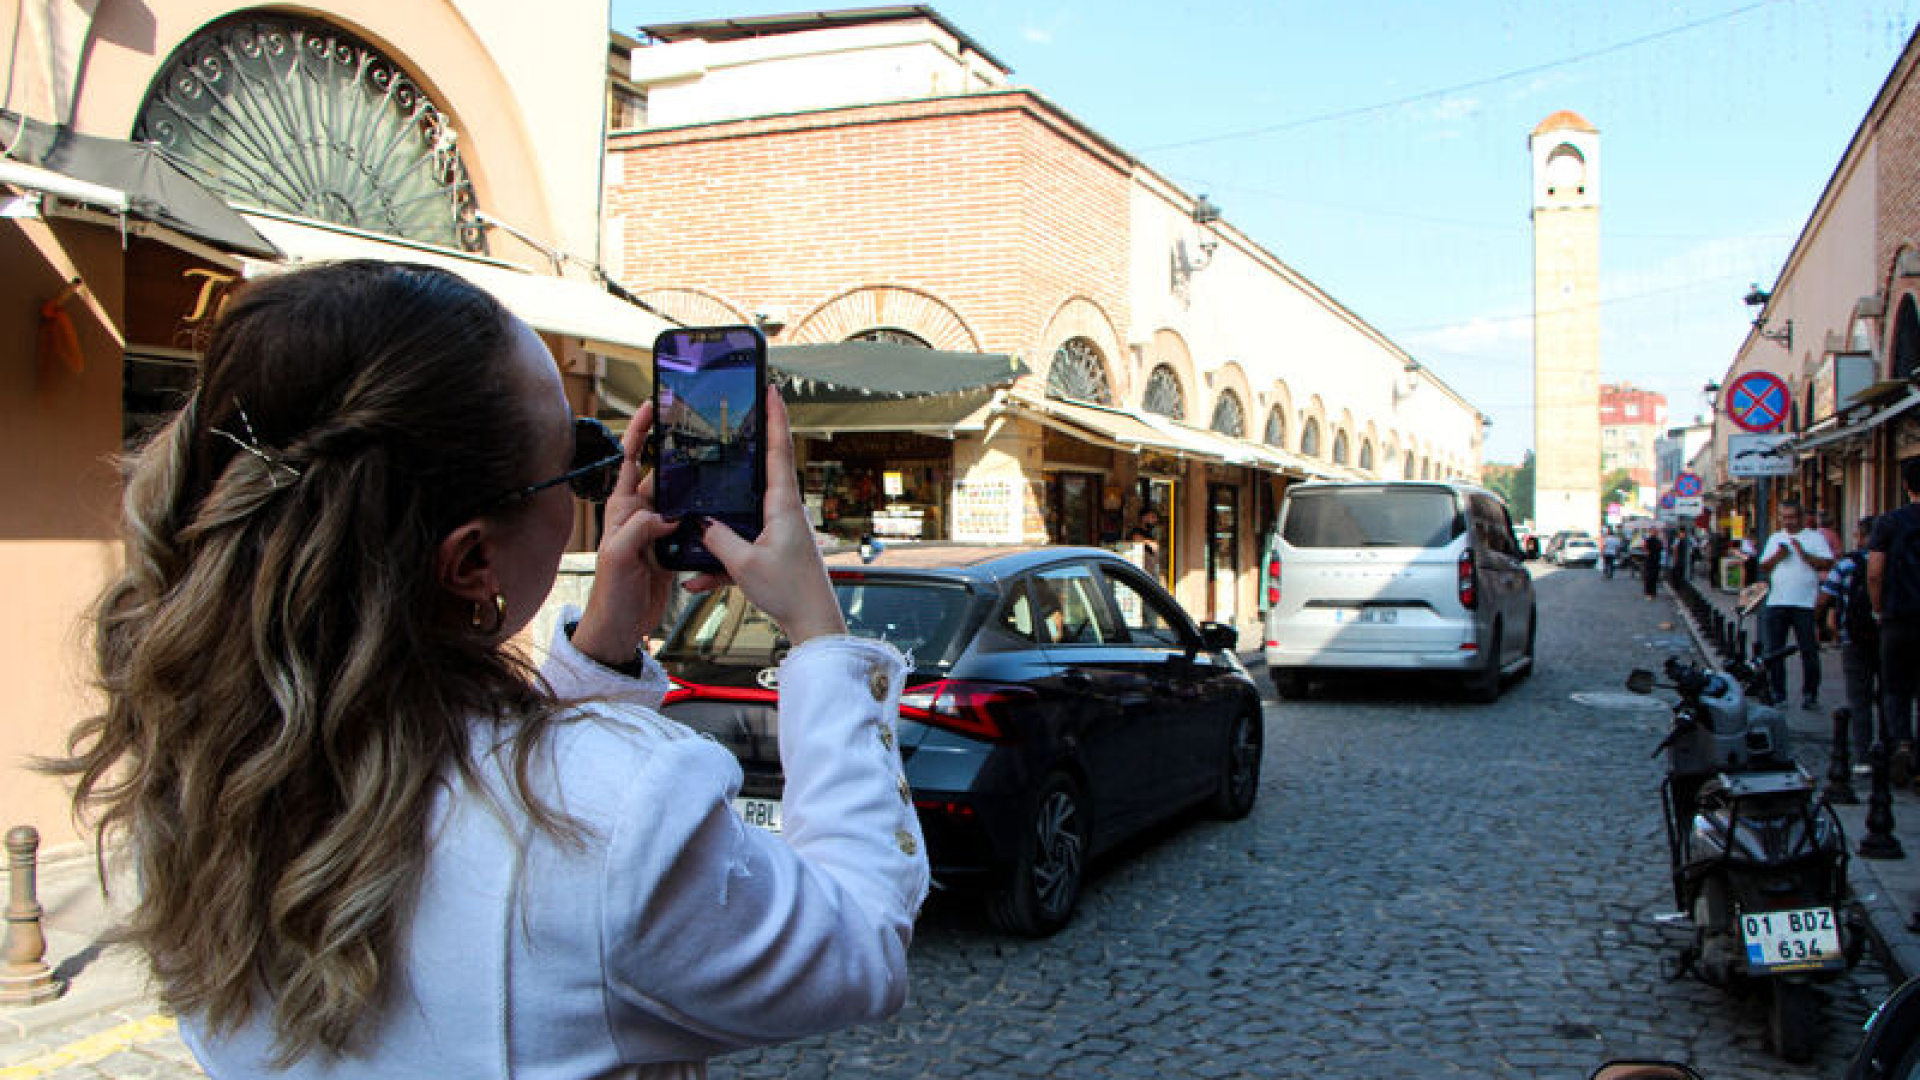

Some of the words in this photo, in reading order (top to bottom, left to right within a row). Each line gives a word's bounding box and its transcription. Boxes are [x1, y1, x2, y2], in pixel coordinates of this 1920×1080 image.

[744, 801, 776, 826] RBL
[1746, 916, 1771, 937] 01
[1788, 911, 1834, 932] BDZ
[1778, 938, 1823, 959] 634
